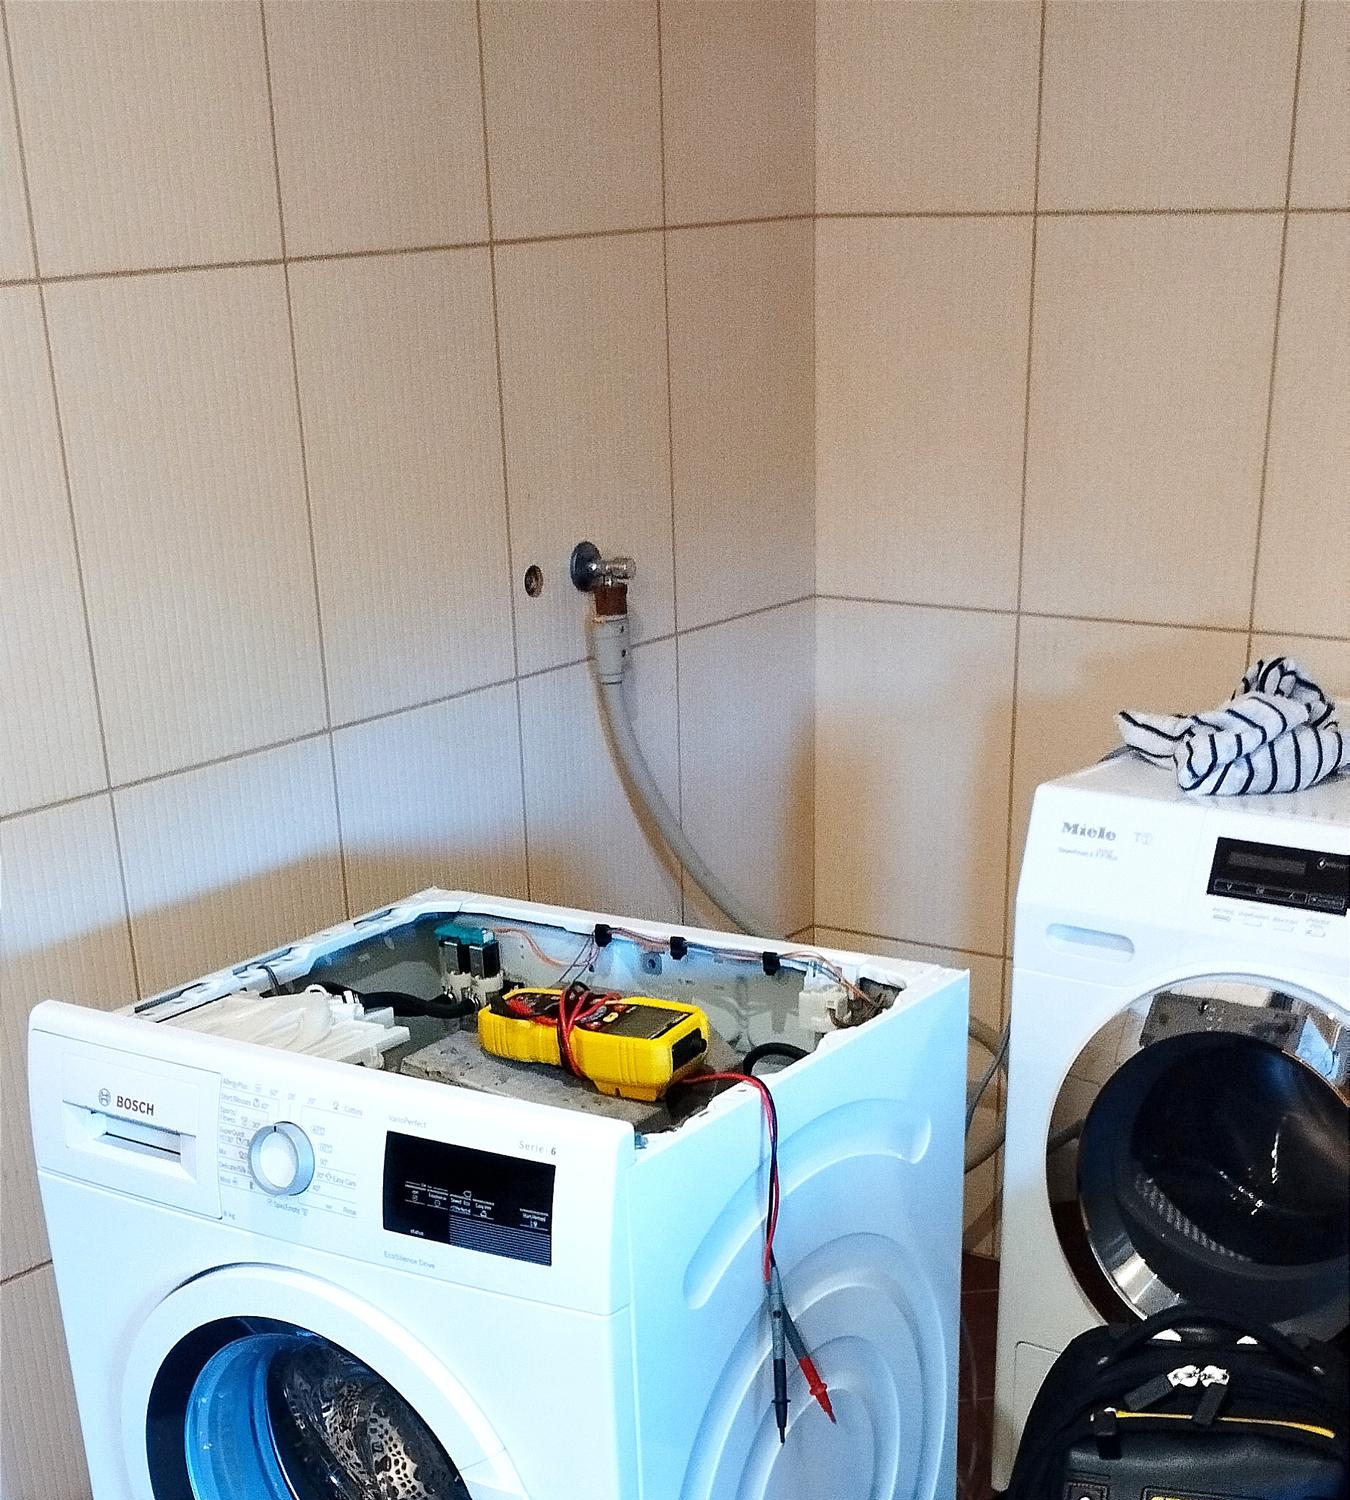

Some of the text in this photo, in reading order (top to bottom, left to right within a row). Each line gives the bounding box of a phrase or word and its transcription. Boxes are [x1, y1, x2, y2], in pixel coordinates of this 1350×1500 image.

[1062, 821, 1117, 841] Miele
[116, 1095, 155, 1116] BOSCH
[519, 1140, 557, 1156] Serie 6
